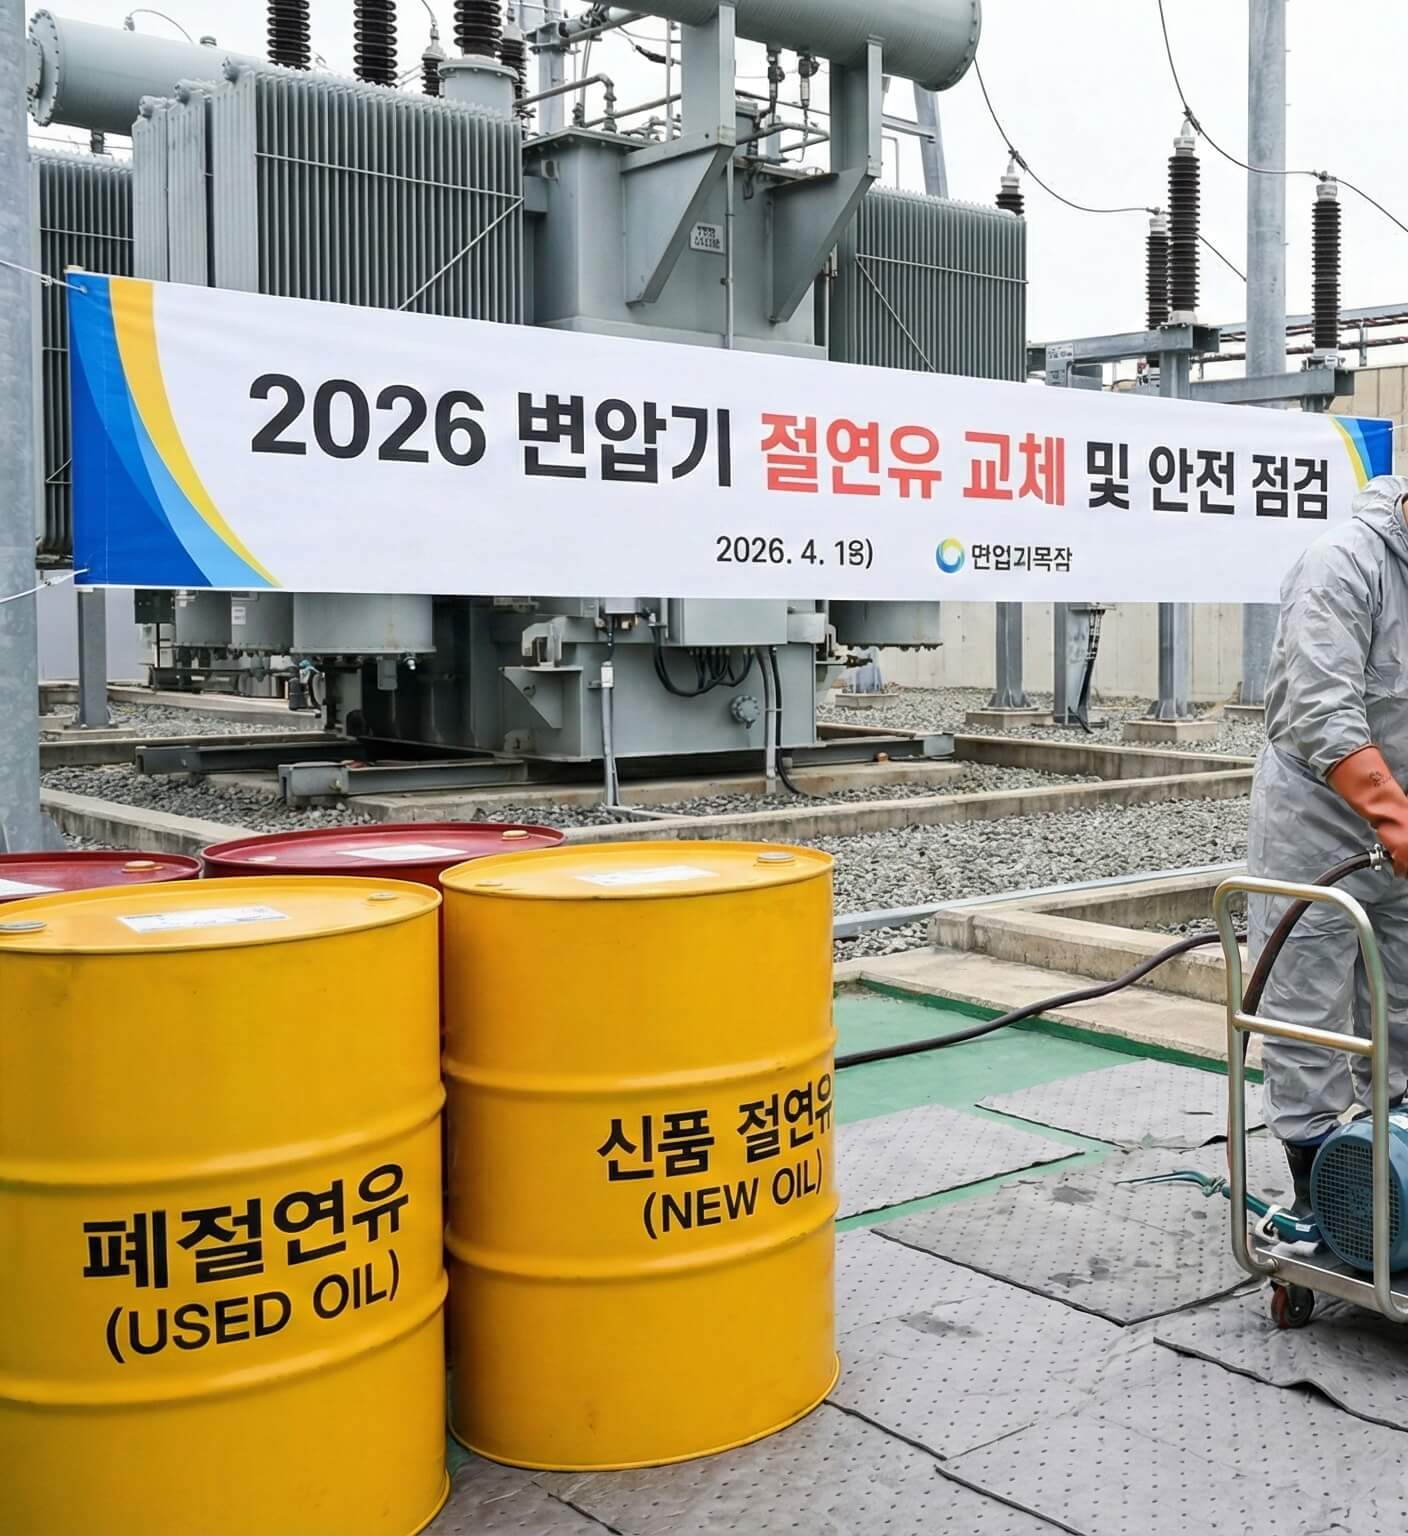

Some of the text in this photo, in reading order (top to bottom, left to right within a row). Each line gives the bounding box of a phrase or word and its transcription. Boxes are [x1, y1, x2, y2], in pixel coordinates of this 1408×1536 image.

[249, 373, 1328, 520] 2026 변압기 절연유 교체 및 안전 점검
[716, 535, 792, 565] 2026.
[800, 539, 825, 566] 4.
[597, 1073, 832, 1182] 신품 절연유
[83, 1163, 409, 1290] 폐절연유
[642, 1147, 823, 1240] (NEW OIL)
[105, 1249, 400, 1365] (USED OIL)
